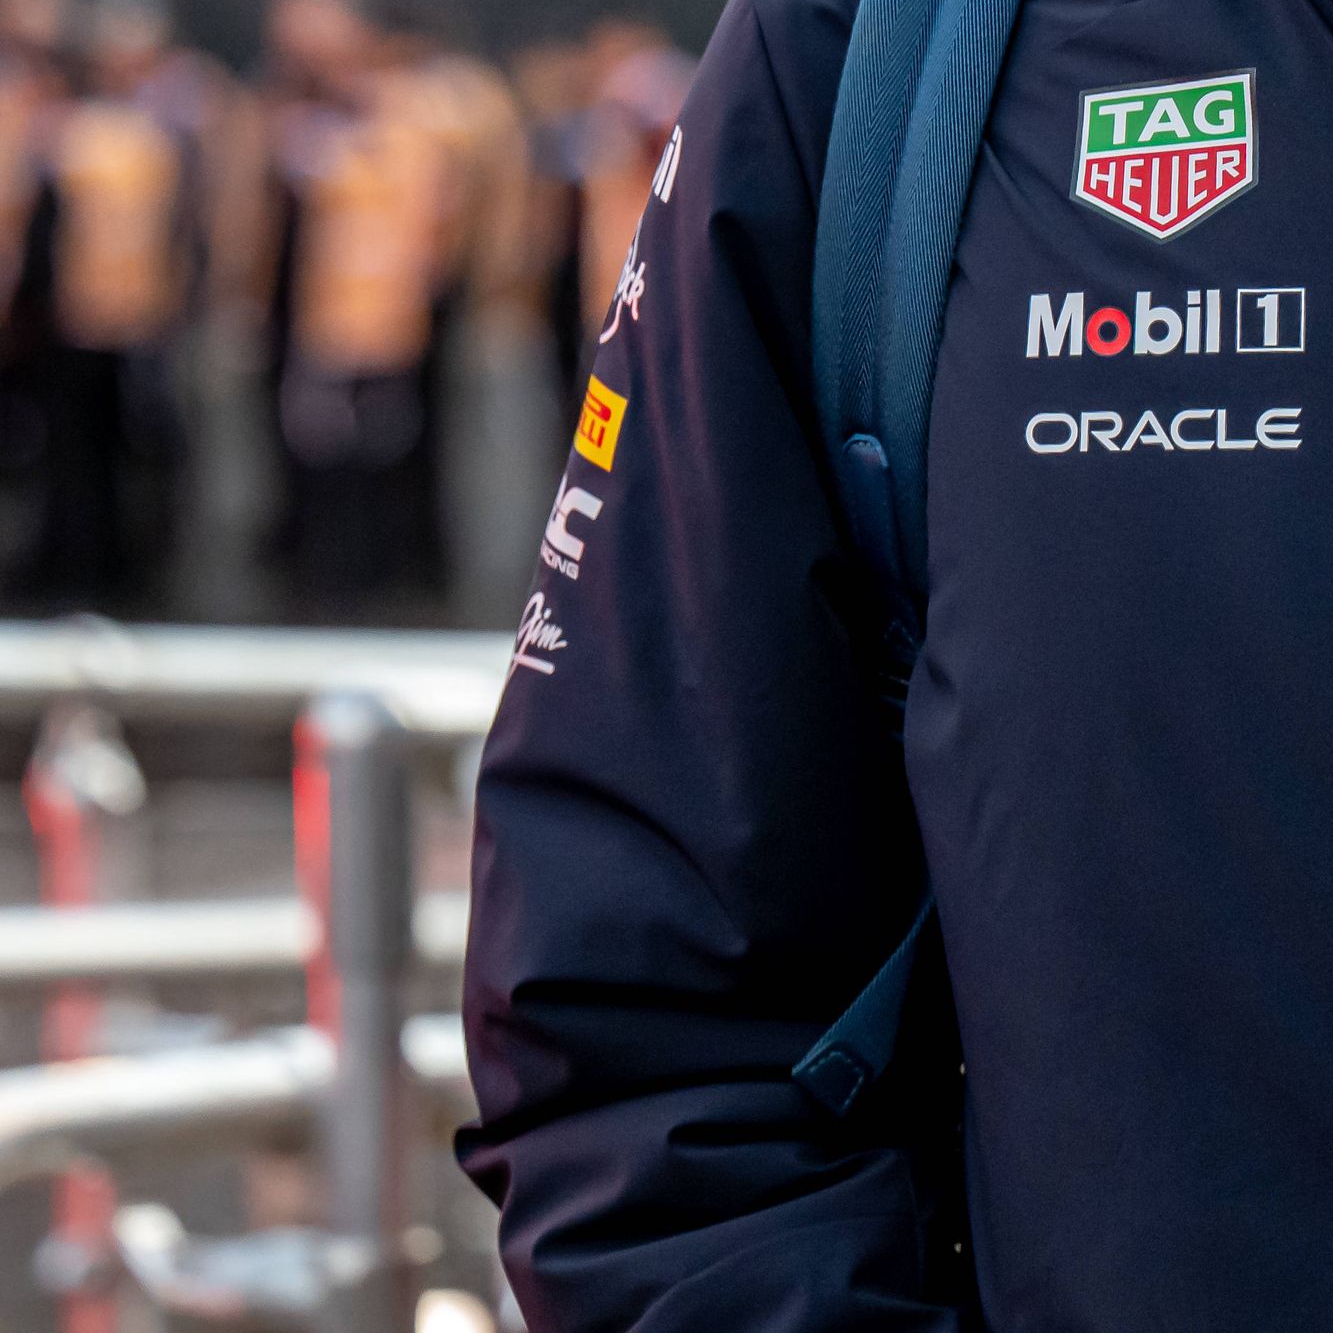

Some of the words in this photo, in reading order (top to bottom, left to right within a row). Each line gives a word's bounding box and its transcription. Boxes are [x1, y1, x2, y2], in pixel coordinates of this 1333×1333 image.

[1098, 89, 1236, 146] TAG
[1089, 149, 1242, 225] HEUER
[1025, 288, 1221, 359] Mobil
[1256, 293, 1281, 347] 1
[1025, 407, 1303, 454] ORACLE
